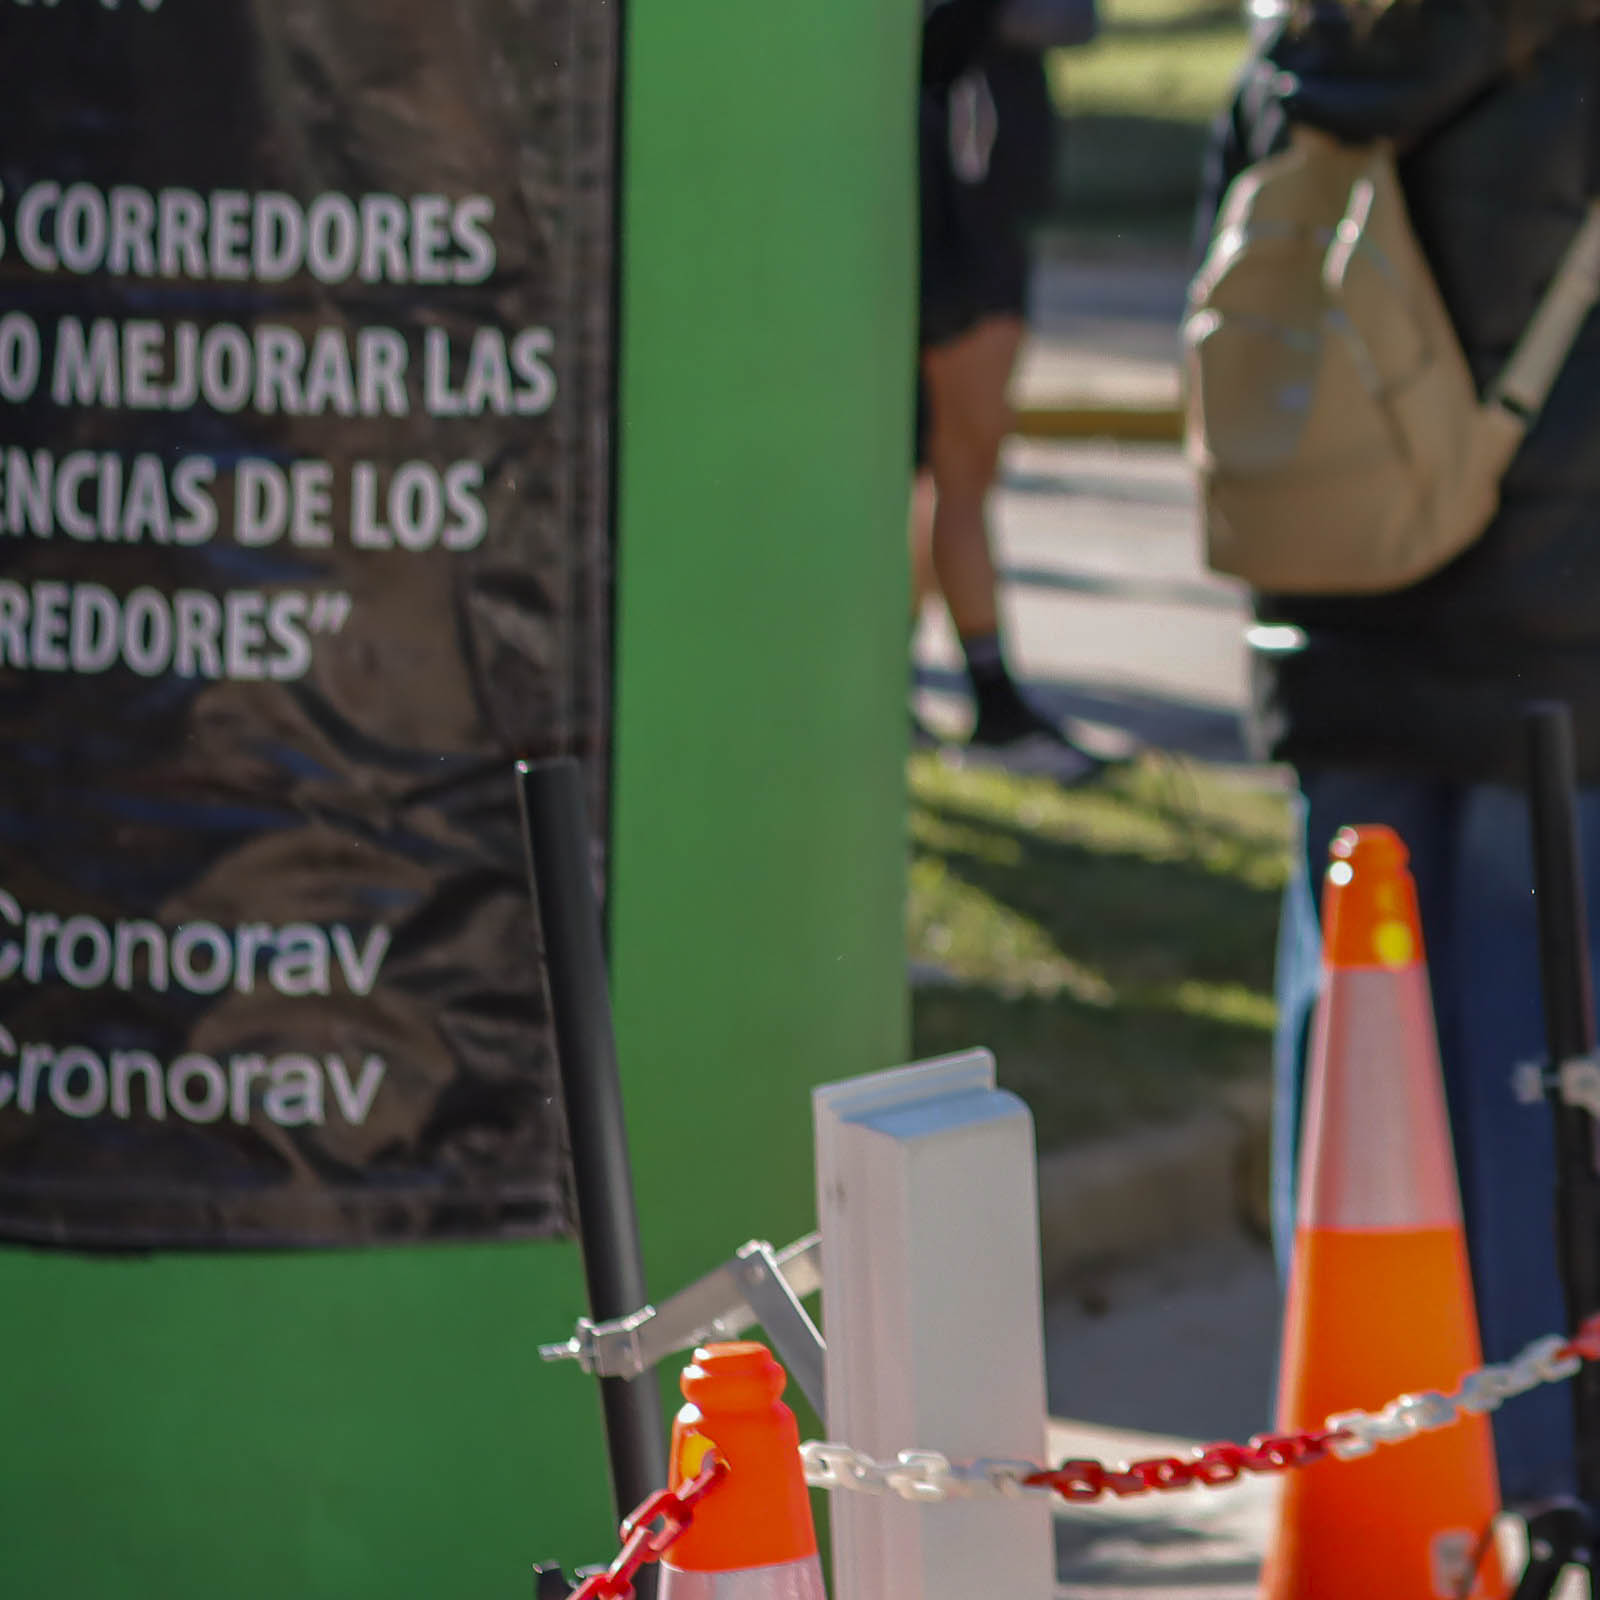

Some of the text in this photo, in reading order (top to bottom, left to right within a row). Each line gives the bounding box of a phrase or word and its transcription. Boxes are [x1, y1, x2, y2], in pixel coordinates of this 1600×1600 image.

[15, 181, 497, 285] CORREDORES
[52, 315, 409, 418] MEJORAR
[424, 326, 557, 416] LAS
[0, 446, 487, 551] NCIAS DE LOS
